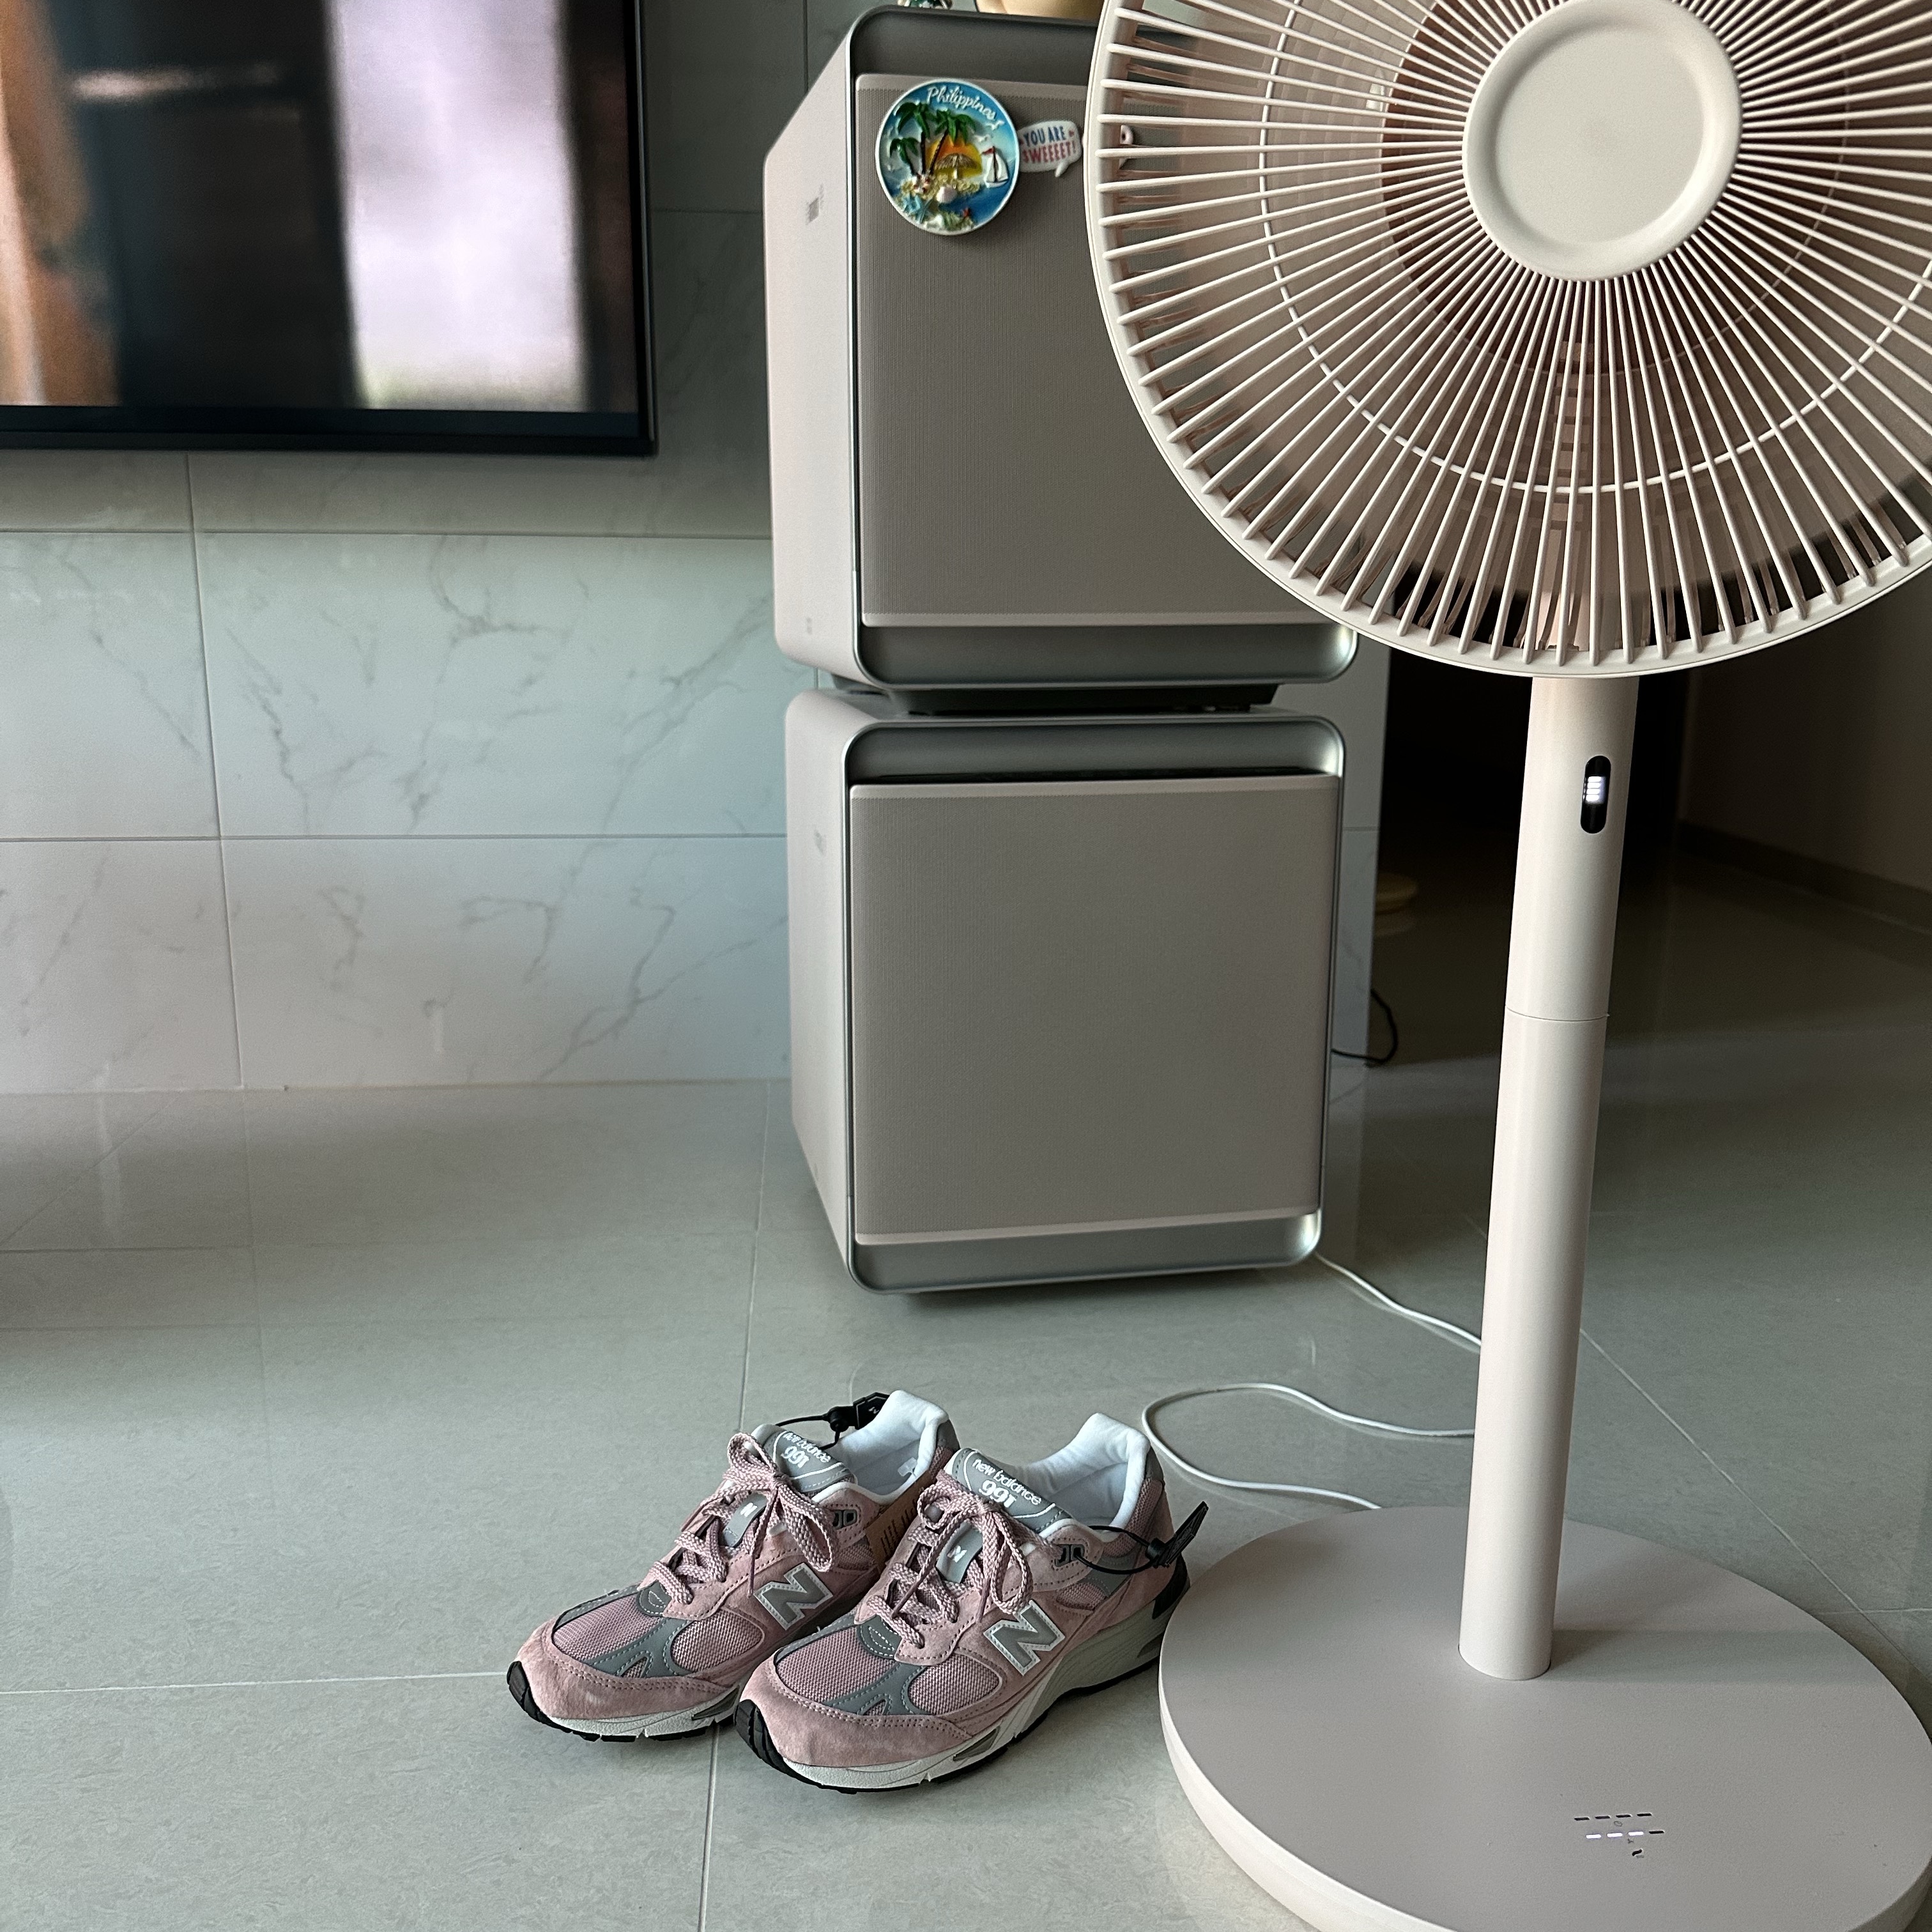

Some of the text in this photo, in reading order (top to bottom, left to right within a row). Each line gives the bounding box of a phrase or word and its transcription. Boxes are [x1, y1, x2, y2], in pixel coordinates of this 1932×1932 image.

[1023, 125, 1066, 147] YOU ARE
[1023, 140, 1077, 164] SWEEEET!
[781, 1446, 810, 1468] 991
[972, 1459, 1042, 1505] new balance
[978, 1480, 1018, 1508] 991
[753, 1562, 833, 1630] N
[983, 1599, 1065, 1676] N
